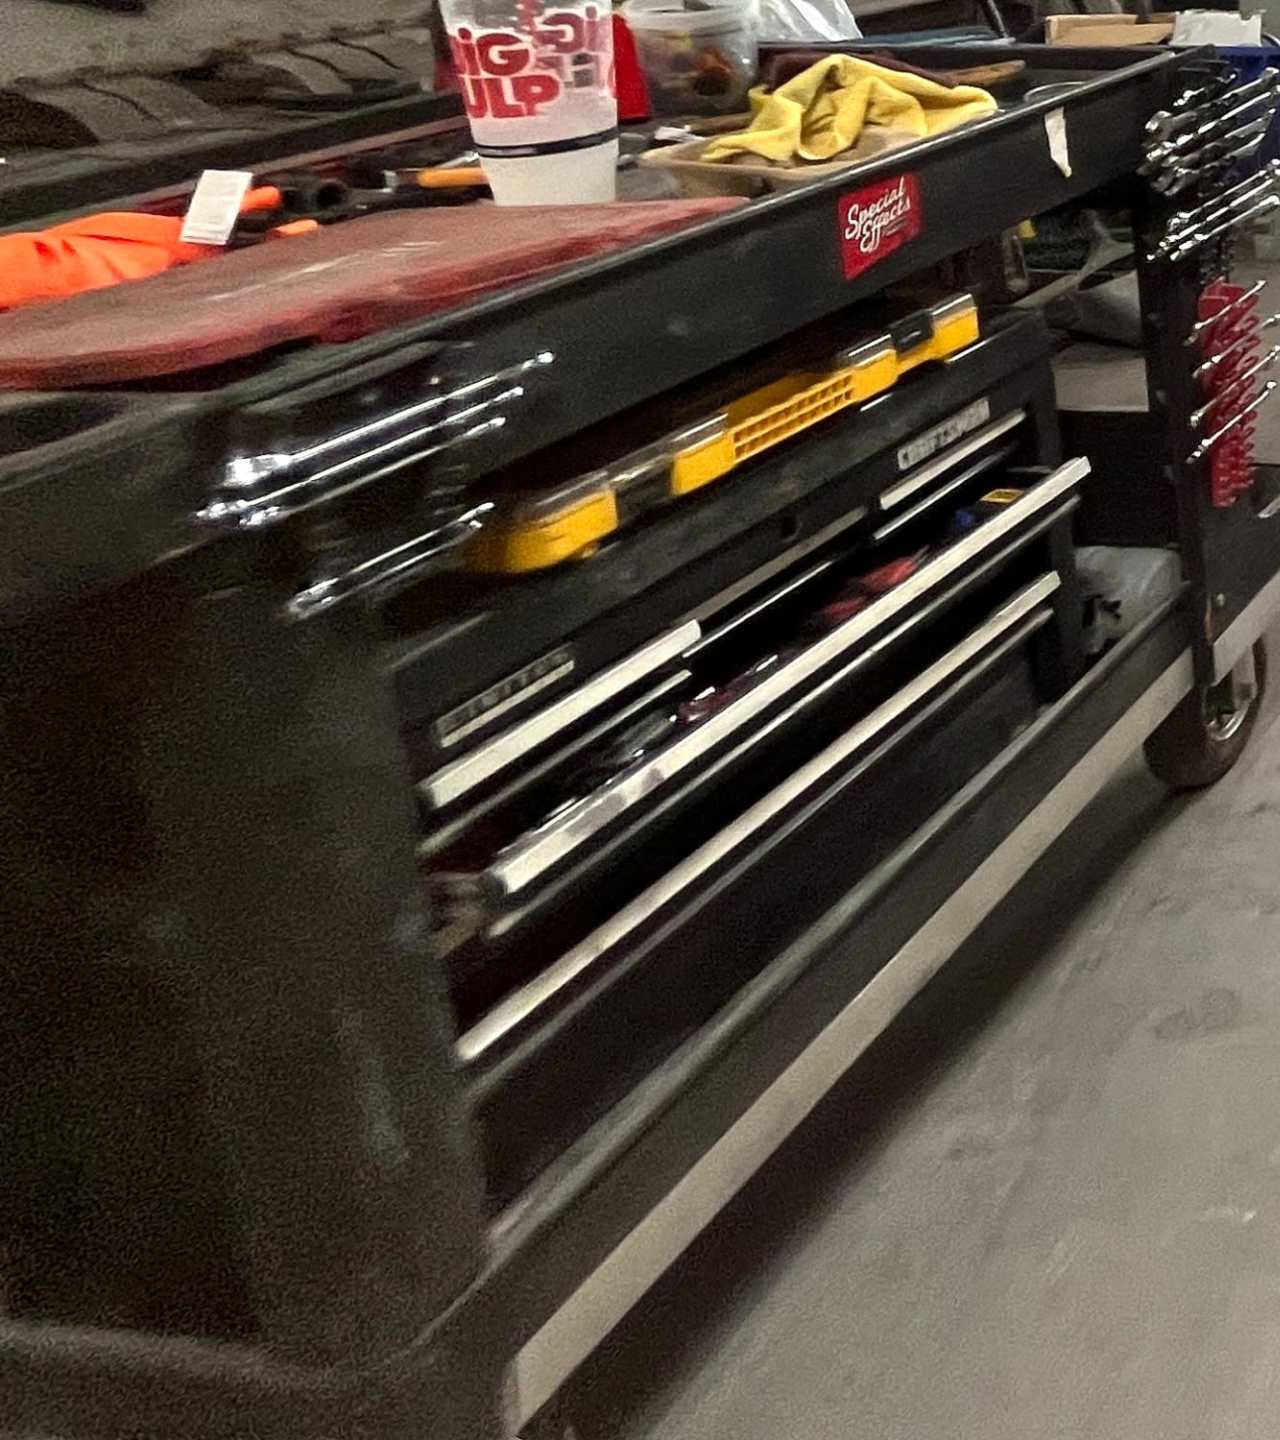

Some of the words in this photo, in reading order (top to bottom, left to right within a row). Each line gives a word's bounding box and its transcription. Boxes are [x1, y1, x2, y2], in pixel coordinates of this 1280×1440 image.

[450, 27, 532, 76] iG
[461, 73, 561, 119] ULP
[845, 175, 905, 240] Special
[860, 196, 911, 253] Effects
